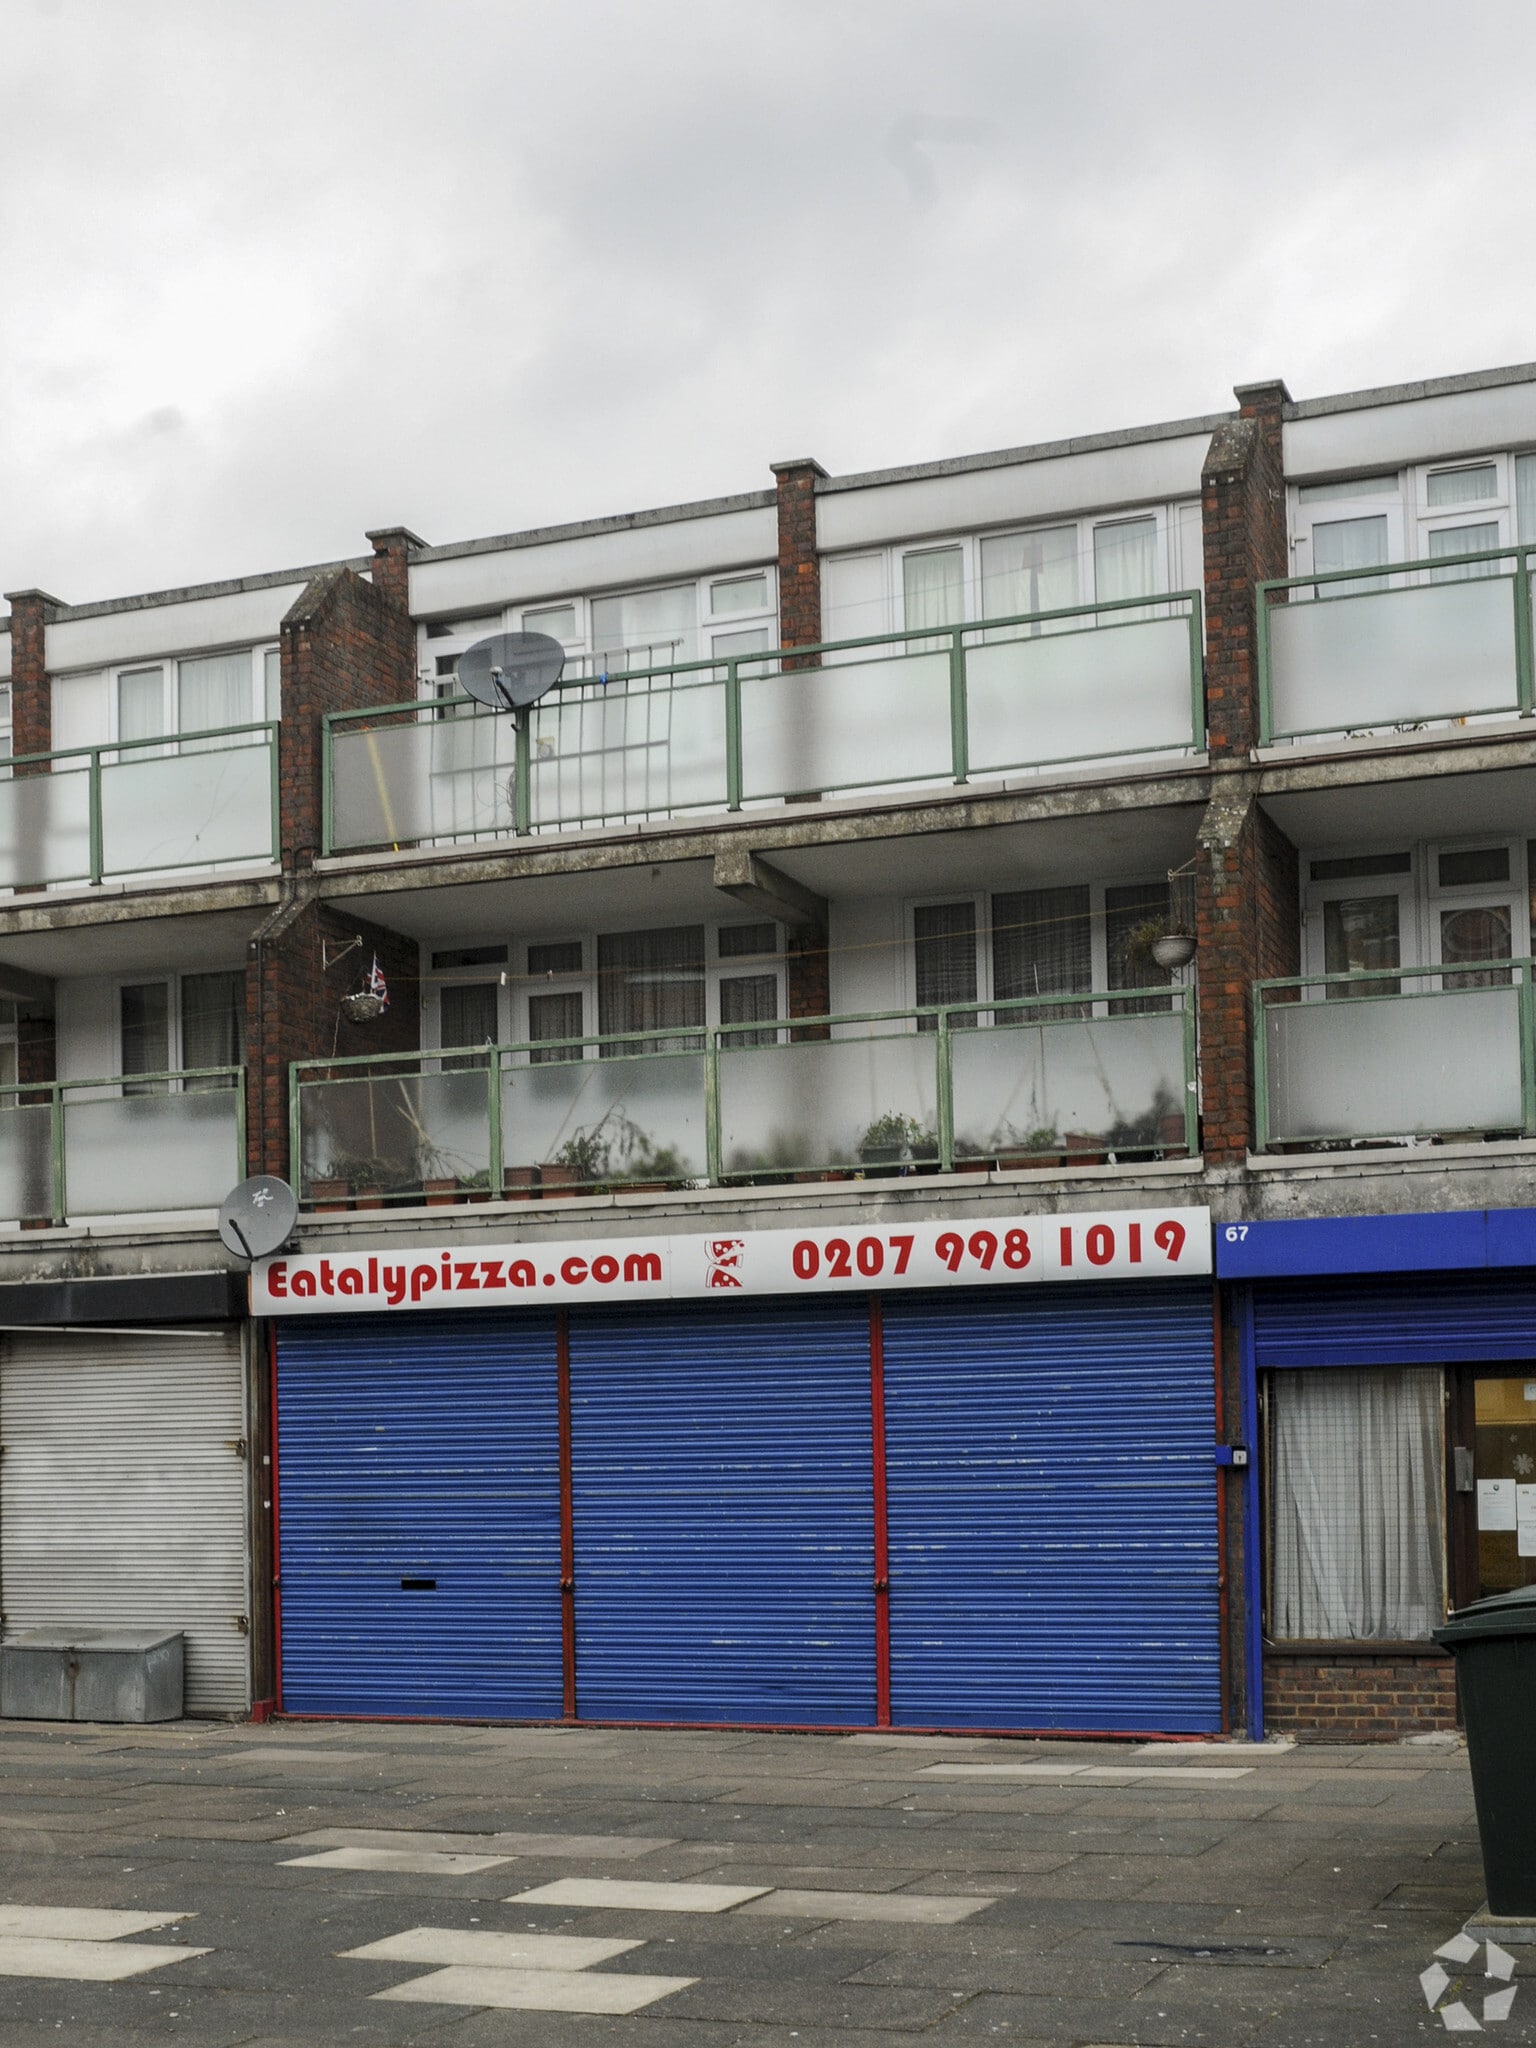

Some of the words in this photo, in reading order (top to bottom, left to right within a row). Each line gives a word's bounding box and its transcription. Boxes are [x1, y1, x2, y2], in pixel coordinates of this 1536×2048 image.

[792, 1235, 915, 1280] 0207
[935, 1229, 1031, 1272] 998
[1060, 1220, 1186, 1265] 1019
[1225, 1226, 1249, 1242] 67
[267, 1252, 662, 1305] Eatalypizza.com
